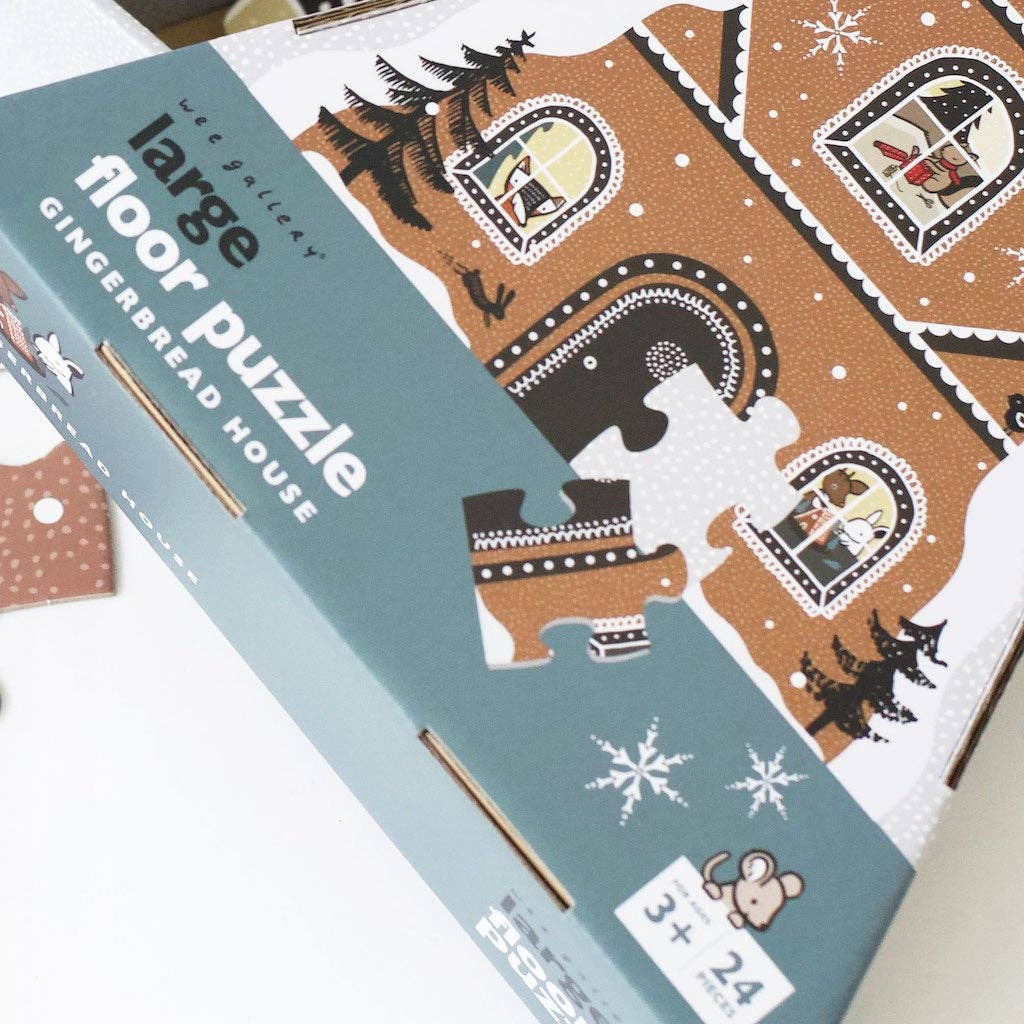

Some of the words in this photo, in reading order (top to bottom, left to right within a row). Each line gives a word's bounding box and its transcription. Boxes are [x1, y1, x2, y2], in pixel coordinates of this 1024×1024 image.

[178, 98, 222, 144] wee
[127, 113, 260, 269] large
[39, 196, 222, 410] GINGERBREAD
[222, 416, 319, 524] HOUSE
[75, 154, 210, 292] floor
[182, 300, 367, 497] puzzle
[489, 906, 588, 1024] floo
[644, 892, 692, 944] 3+
[710, 951, 764, 1005] 24
